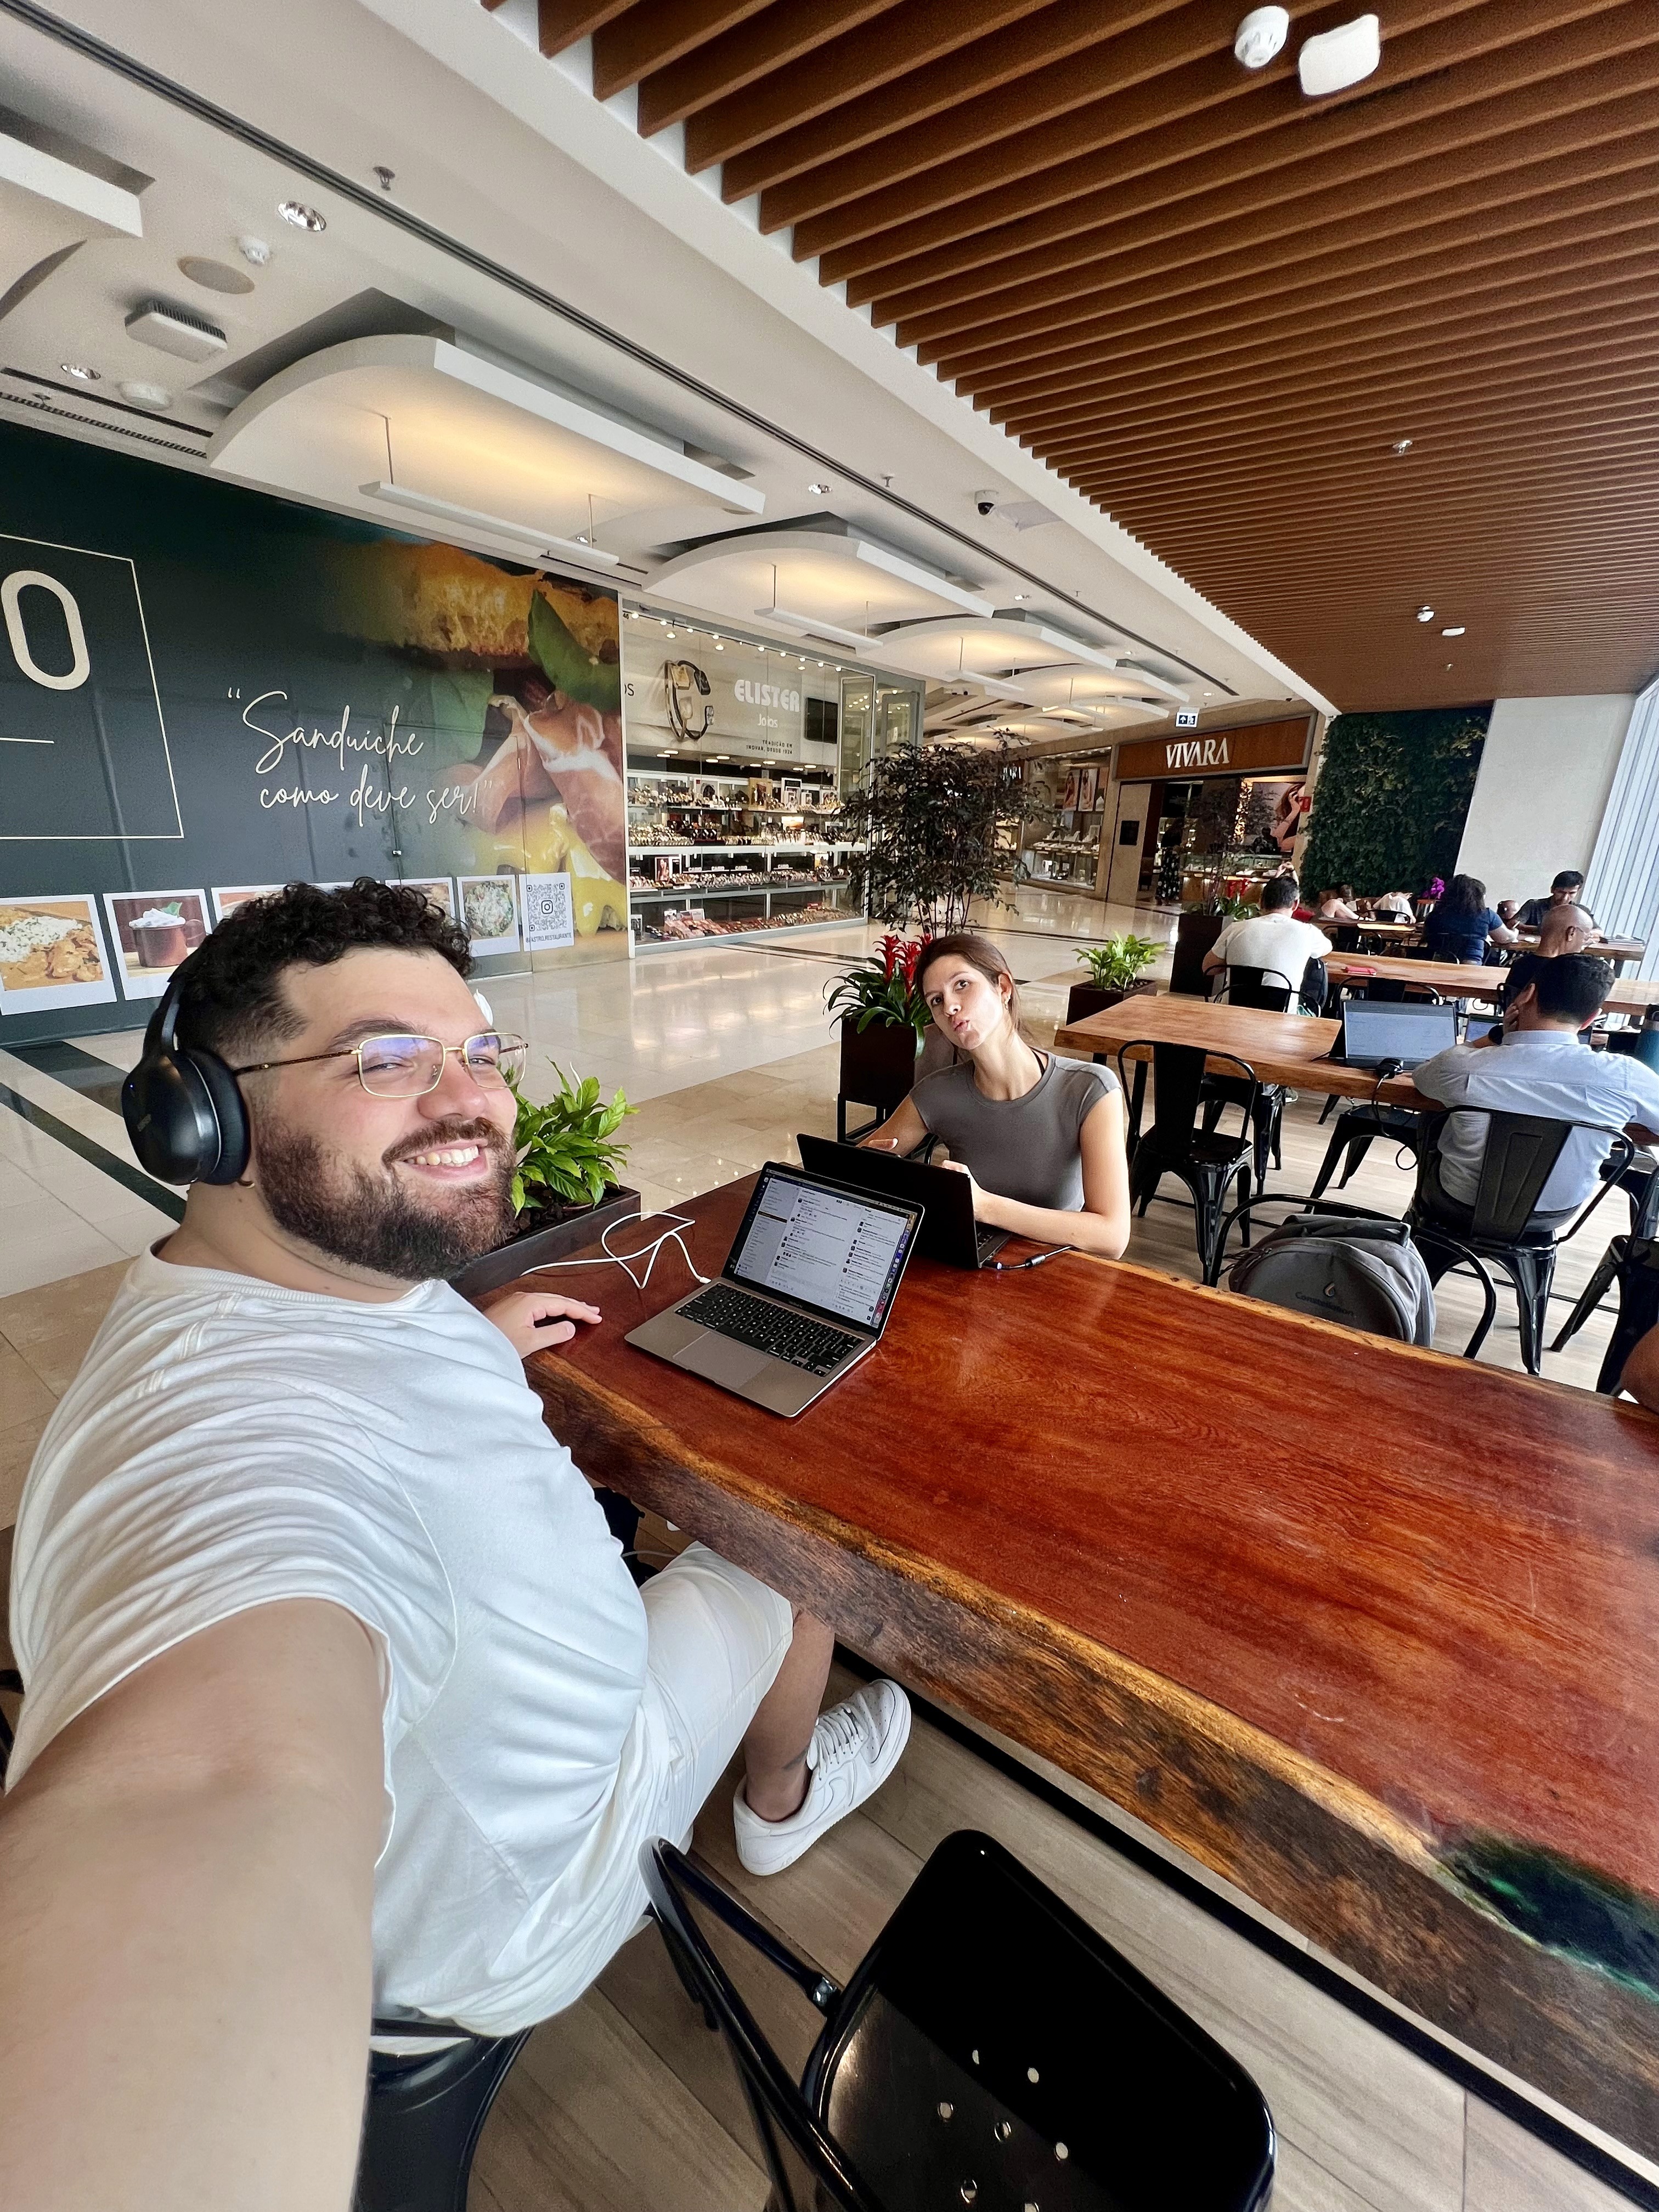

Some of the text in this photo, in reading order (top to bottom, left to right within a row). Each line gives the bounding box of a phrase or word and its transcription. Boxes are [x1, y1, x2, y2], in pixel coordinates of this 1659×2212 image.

[1165, 737, 1230, 769] VIVARA
[259, 787, 339, 809] como
[349, 763, 416, 827] deve
